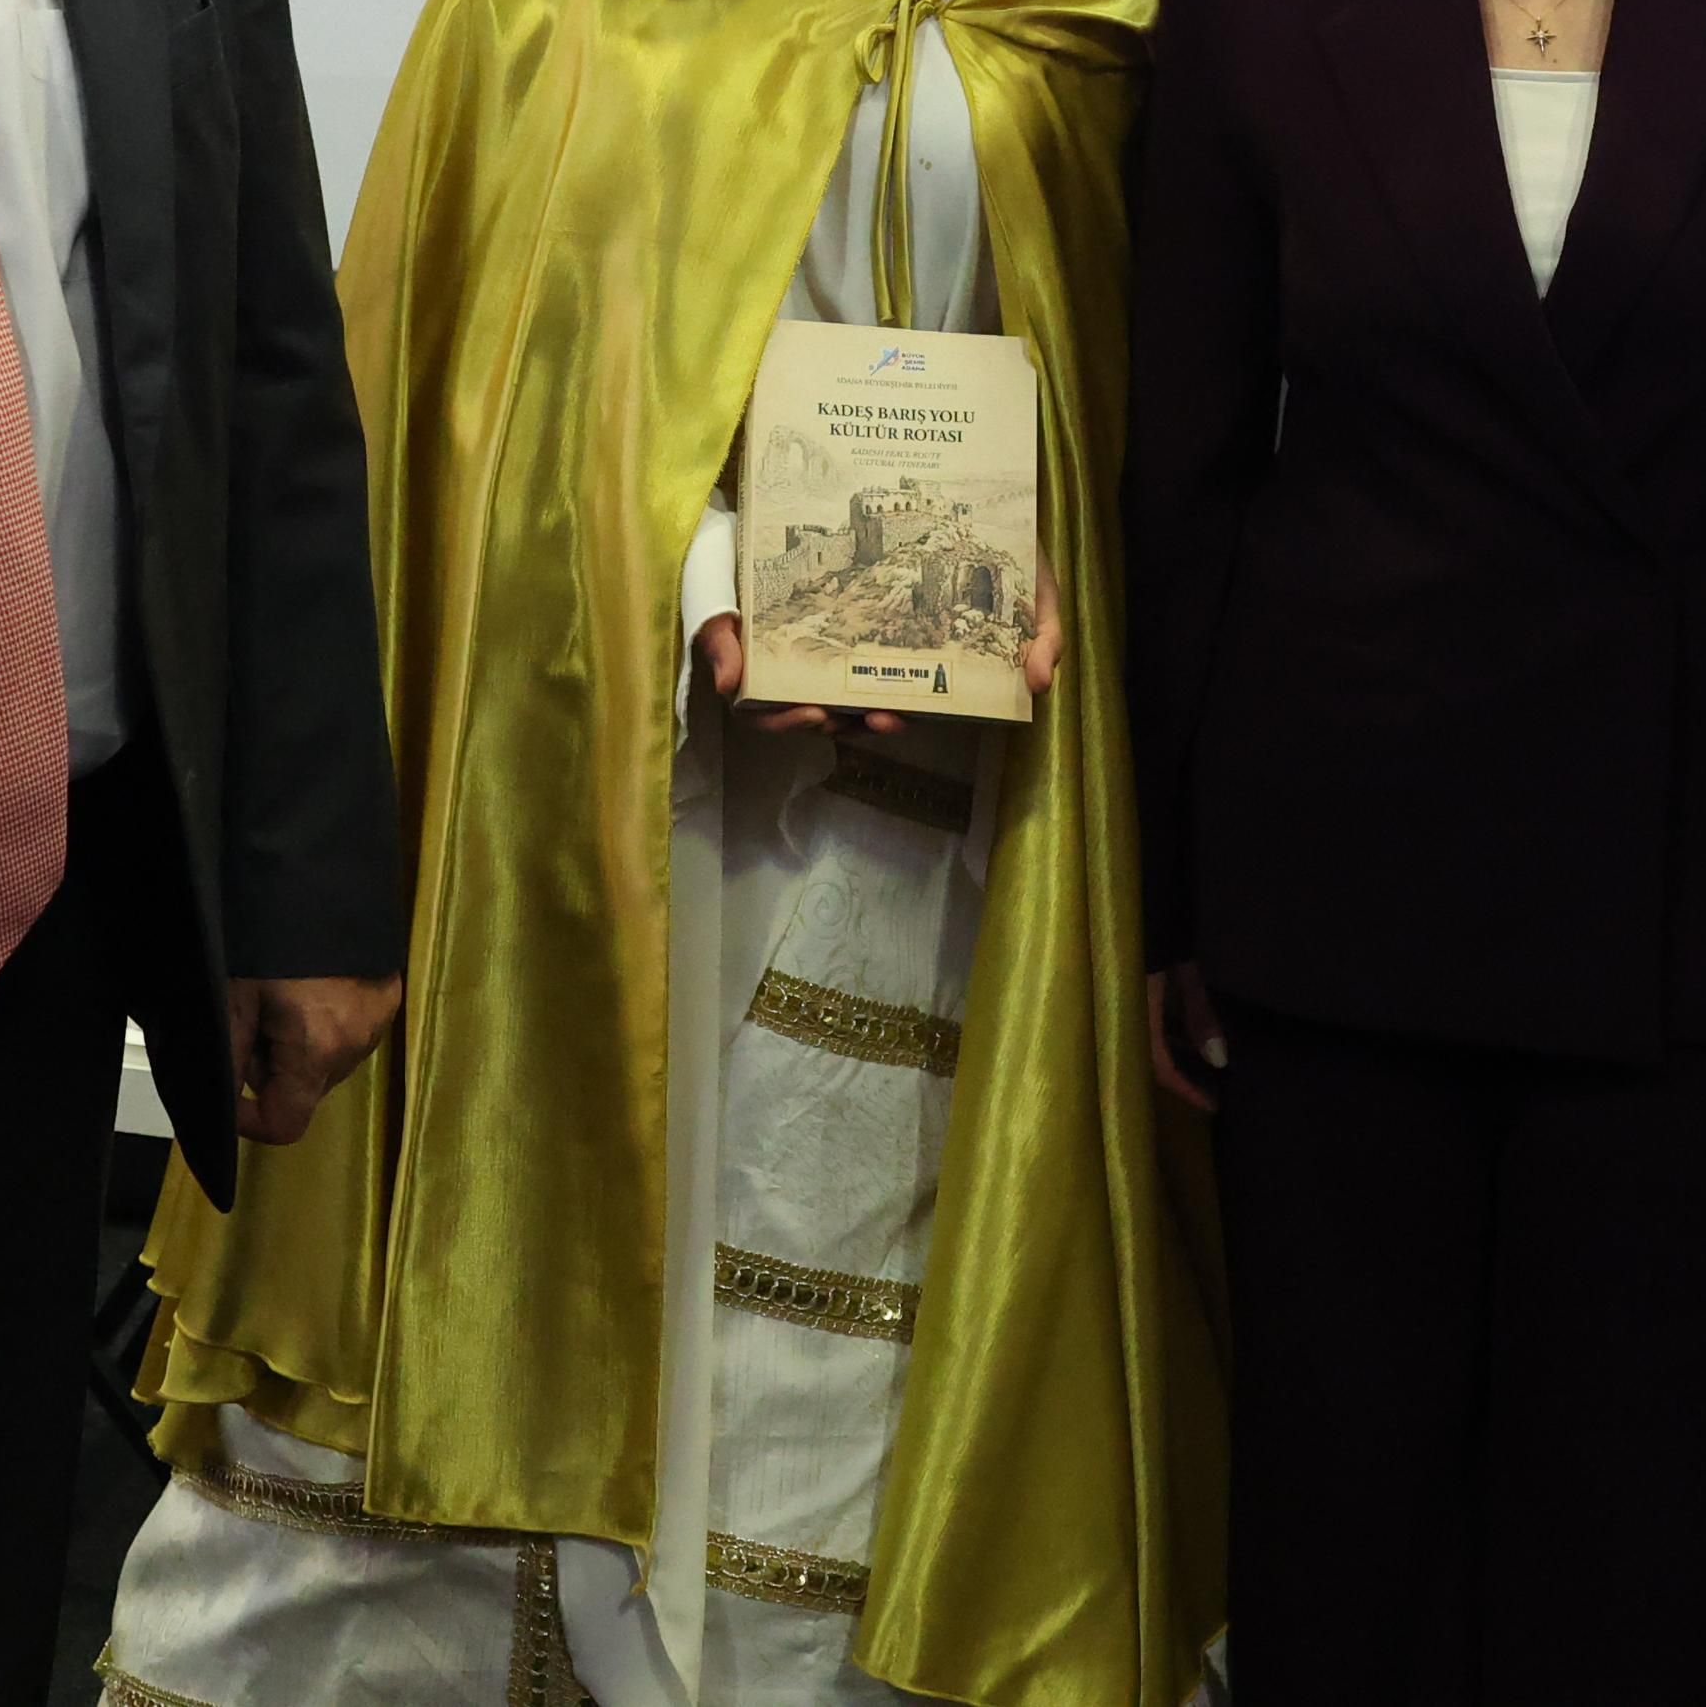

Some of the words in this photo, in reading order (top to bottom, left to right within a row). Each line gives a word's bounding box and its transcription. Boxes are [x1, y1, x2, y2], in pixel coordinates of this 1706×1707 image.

[818, 402, 874, 421] KADEŞ
[878, 406, 926, 424] BARIŞ
[929, 409, 975, 424] YOLU
[830, 421, 899, 440] KÜLTÜR
[903, 428, 963, 443] ROTASI
